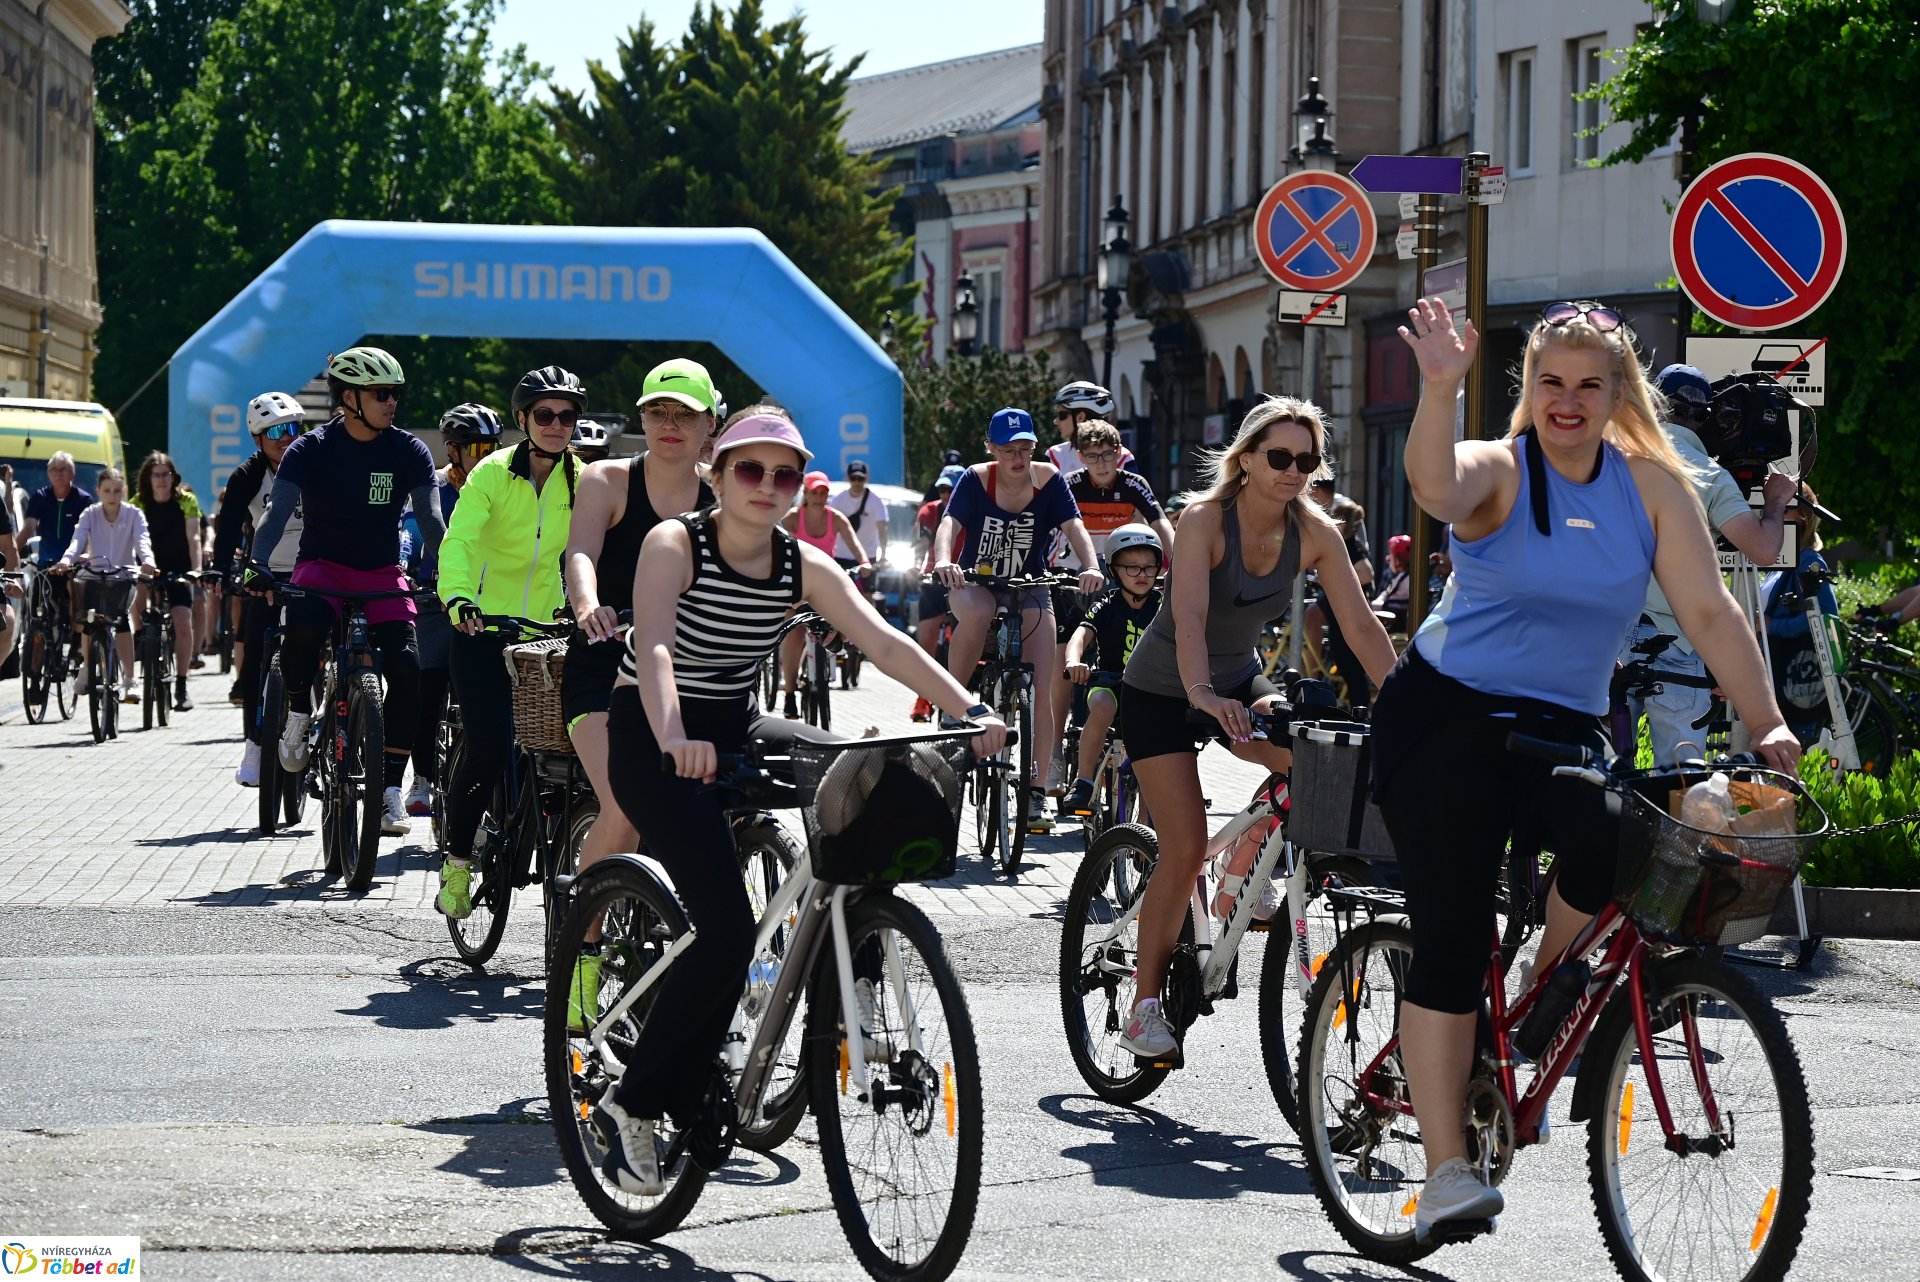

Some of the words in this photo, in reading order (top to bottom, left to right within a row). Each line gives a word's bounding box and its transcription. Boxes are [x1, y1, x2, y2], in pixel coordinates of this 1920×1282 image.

[414, 261, 671, 301] SHIMANO
[370, 475, 393, 488] WRK
[368, 487, 393, 502] OUT
[983, 511, 1035, 534] BG
[590, 879, 622, 896] KENDA
[1295, 918, 1308, 960] 80MM
